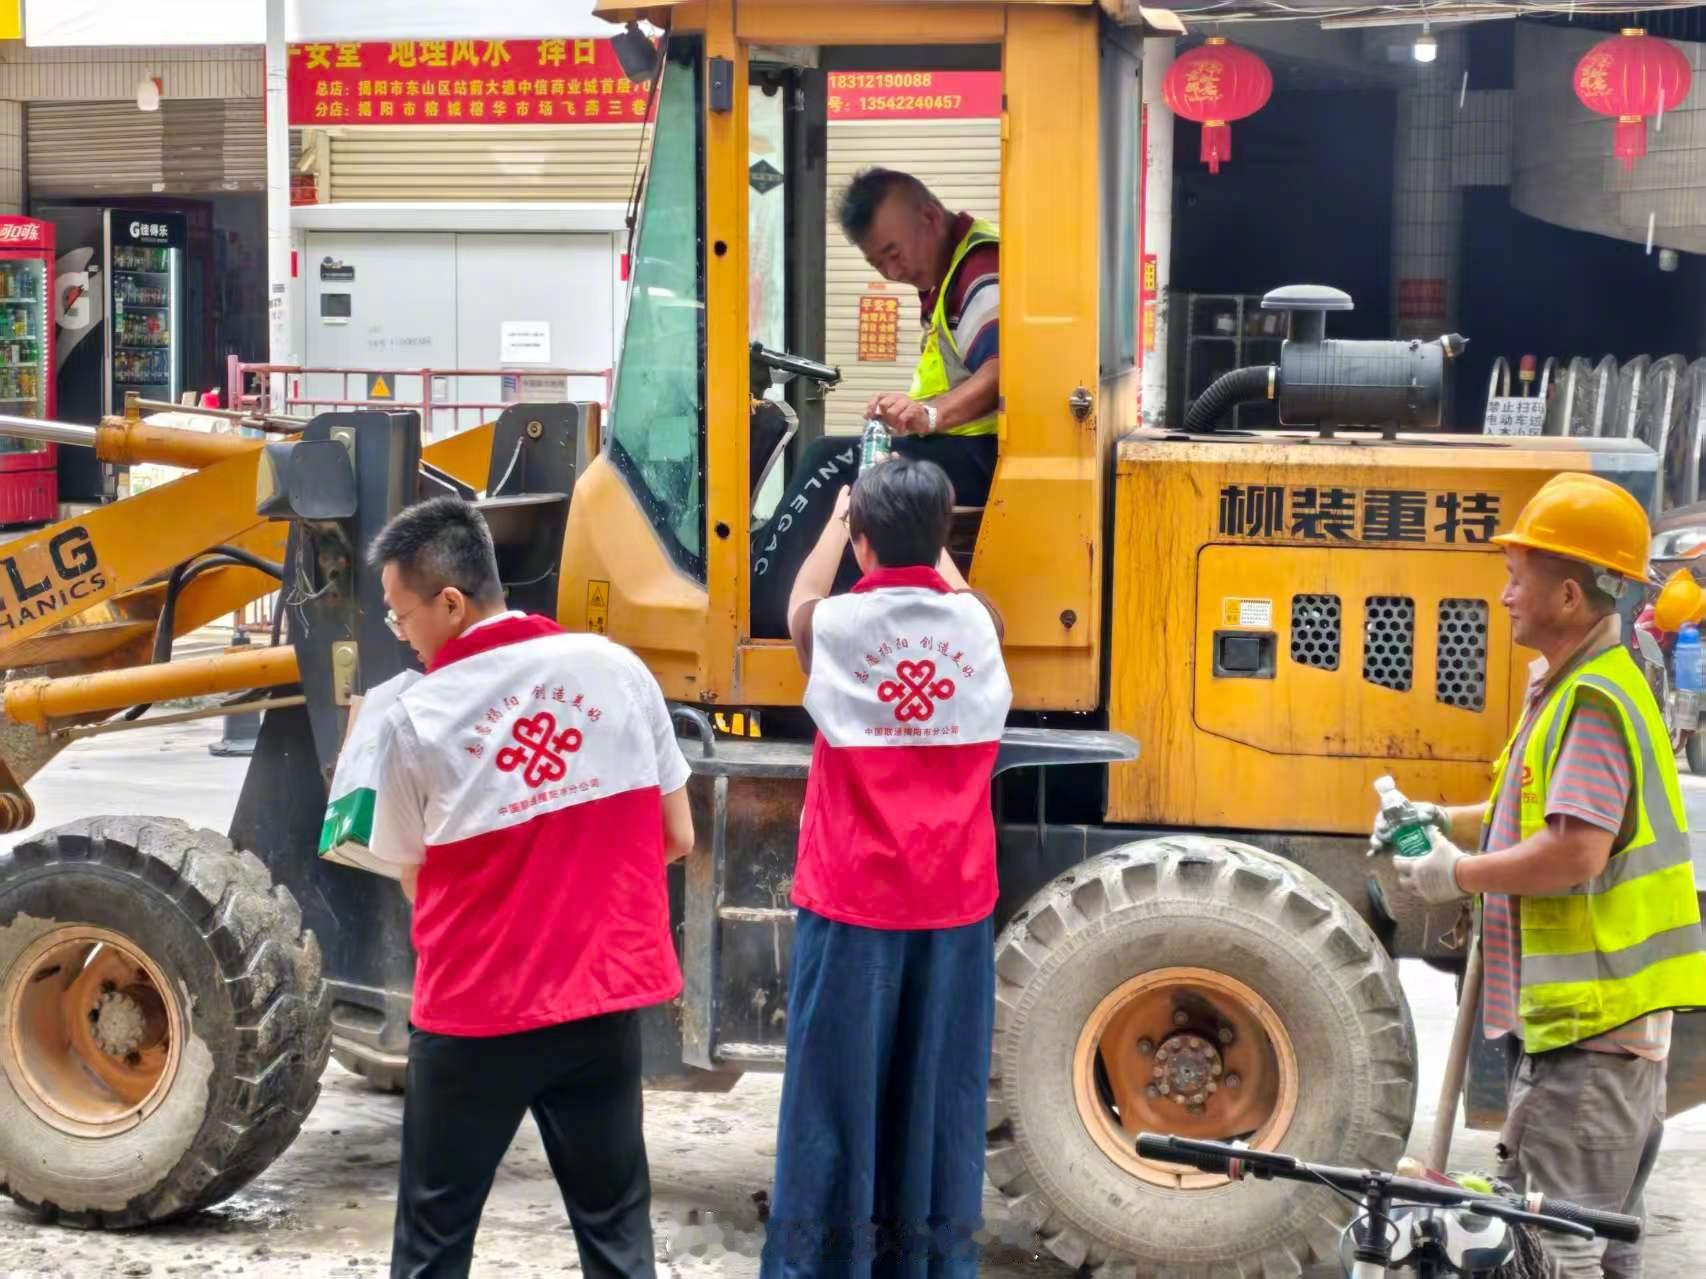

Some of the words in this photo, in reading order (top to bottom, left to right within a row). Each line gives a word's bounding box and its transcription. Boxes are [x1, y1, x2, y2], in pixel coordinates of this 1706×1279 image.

[288, 42, 362, 69] 安堂
[388, 40, 511, 67] 地理风水
[829, 73, 932, 89] 18312190088
[754, 446, 858, 576] ANLEGAC
[1219, 484, 1500, 544] 柳装重特
[0, 526, 97, 610] LG
